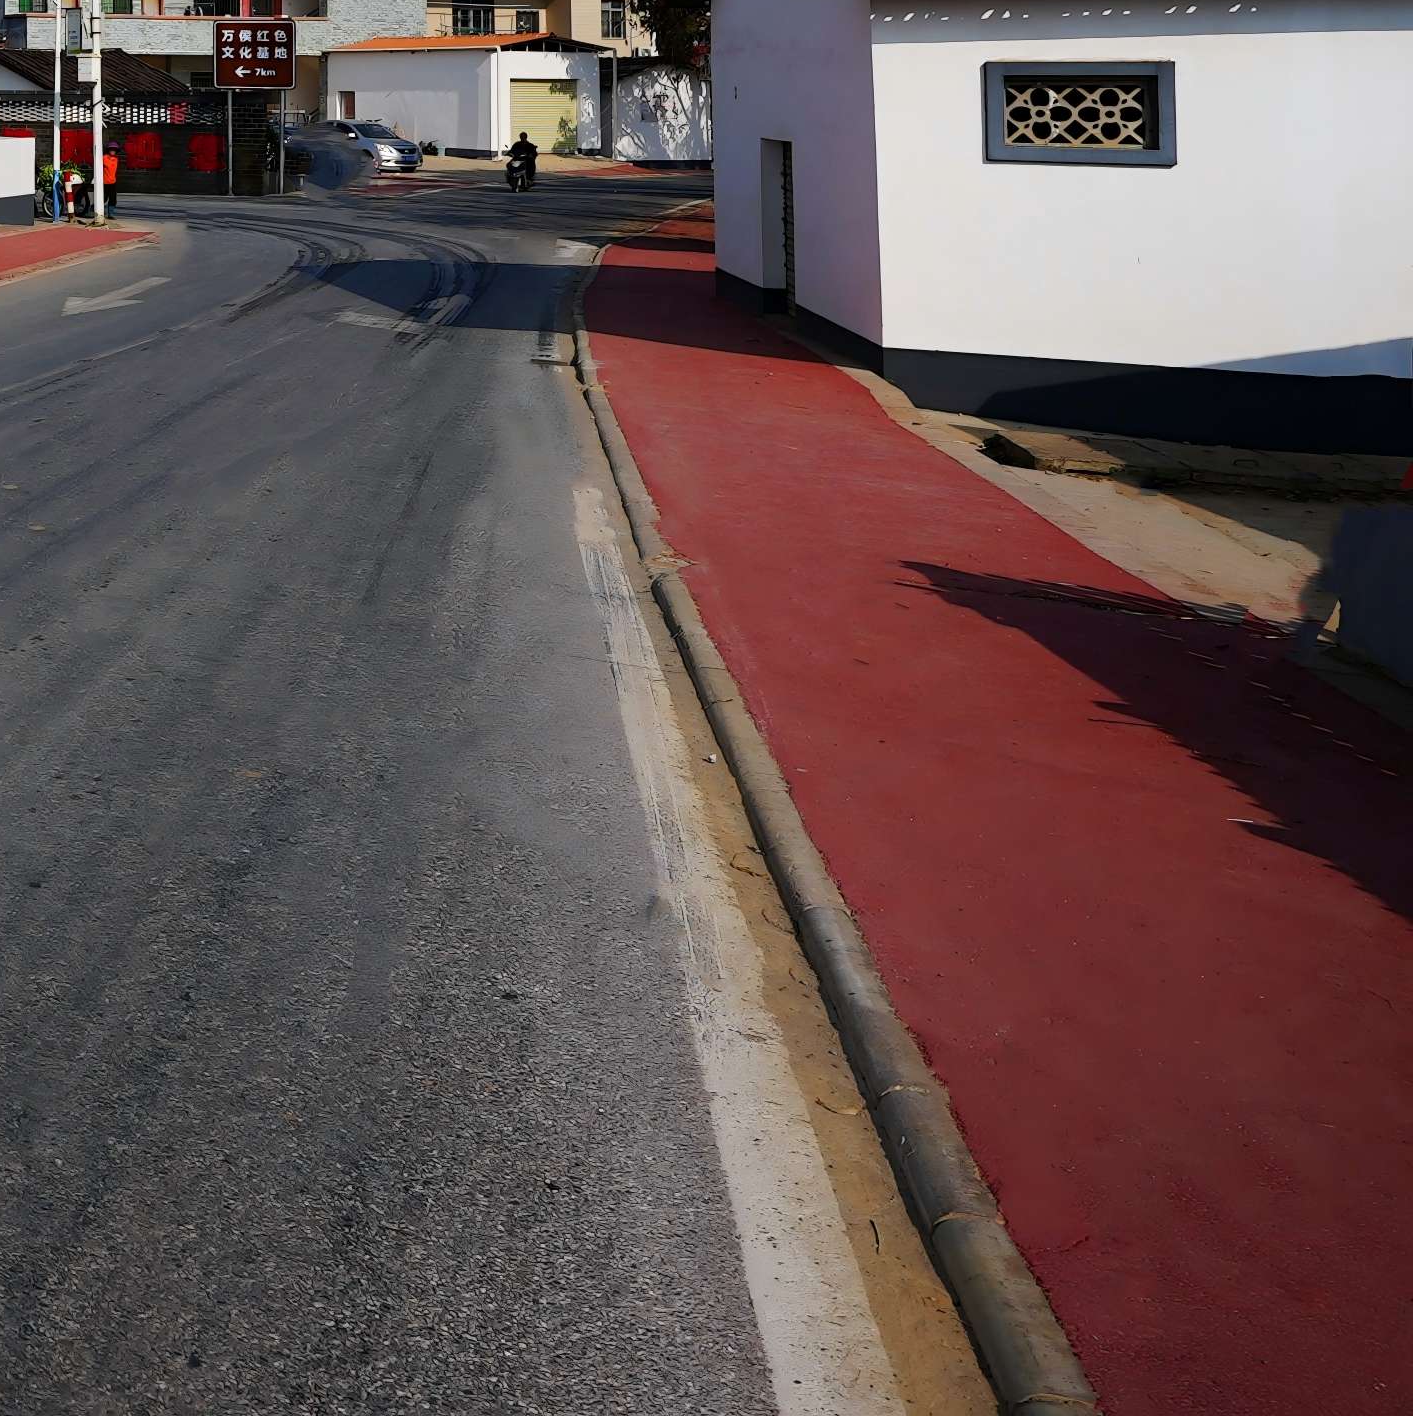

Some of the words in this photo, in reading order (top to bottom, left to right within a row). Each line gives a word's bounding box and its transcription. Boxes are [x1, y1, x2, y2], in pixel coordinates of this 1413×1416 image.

[221, 46, 287, 59] 文化基地
[254, 68, 276, 77] 7km
